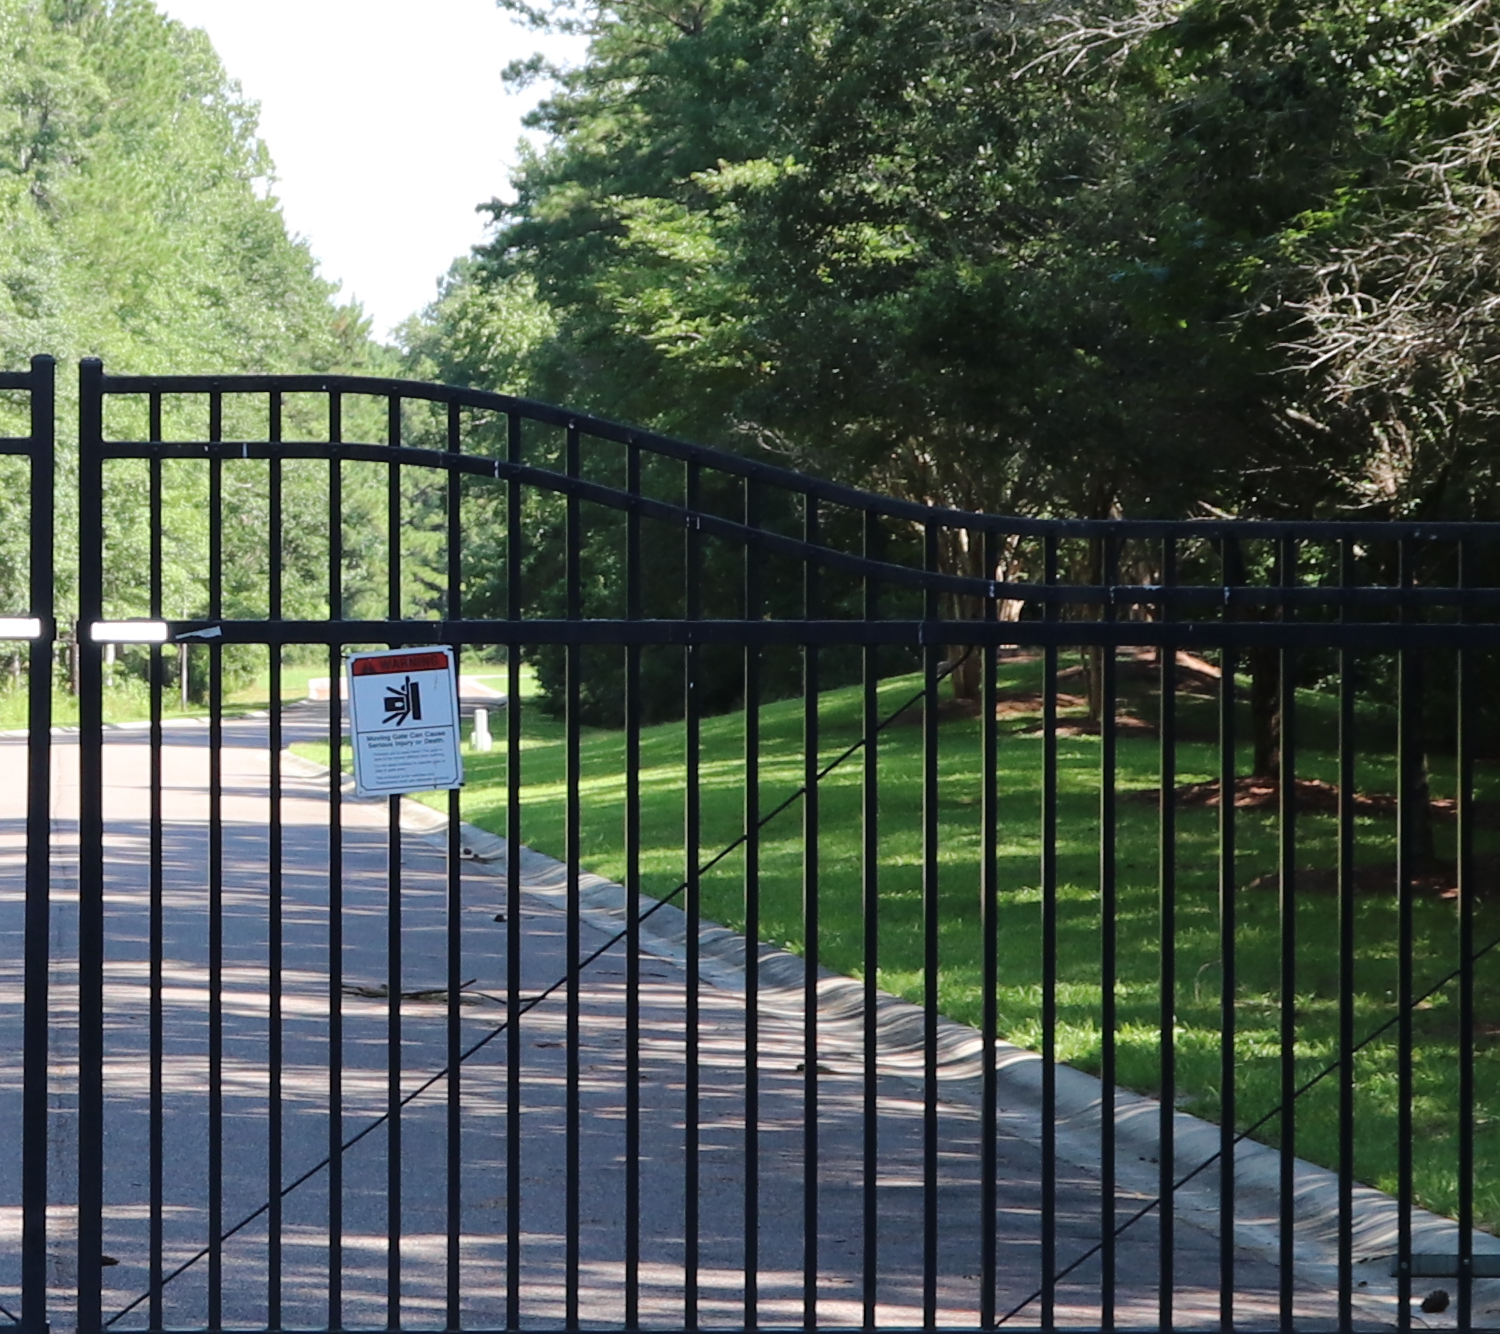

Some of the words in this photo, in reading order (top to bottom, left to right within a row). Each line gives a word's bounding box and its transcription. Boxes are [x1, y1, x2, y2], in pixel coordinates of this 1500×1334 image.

[380, 655, 439, 669] WARNING
[366, 734, 392, 743] Moving
[424, 730, 446, 738] Cause
